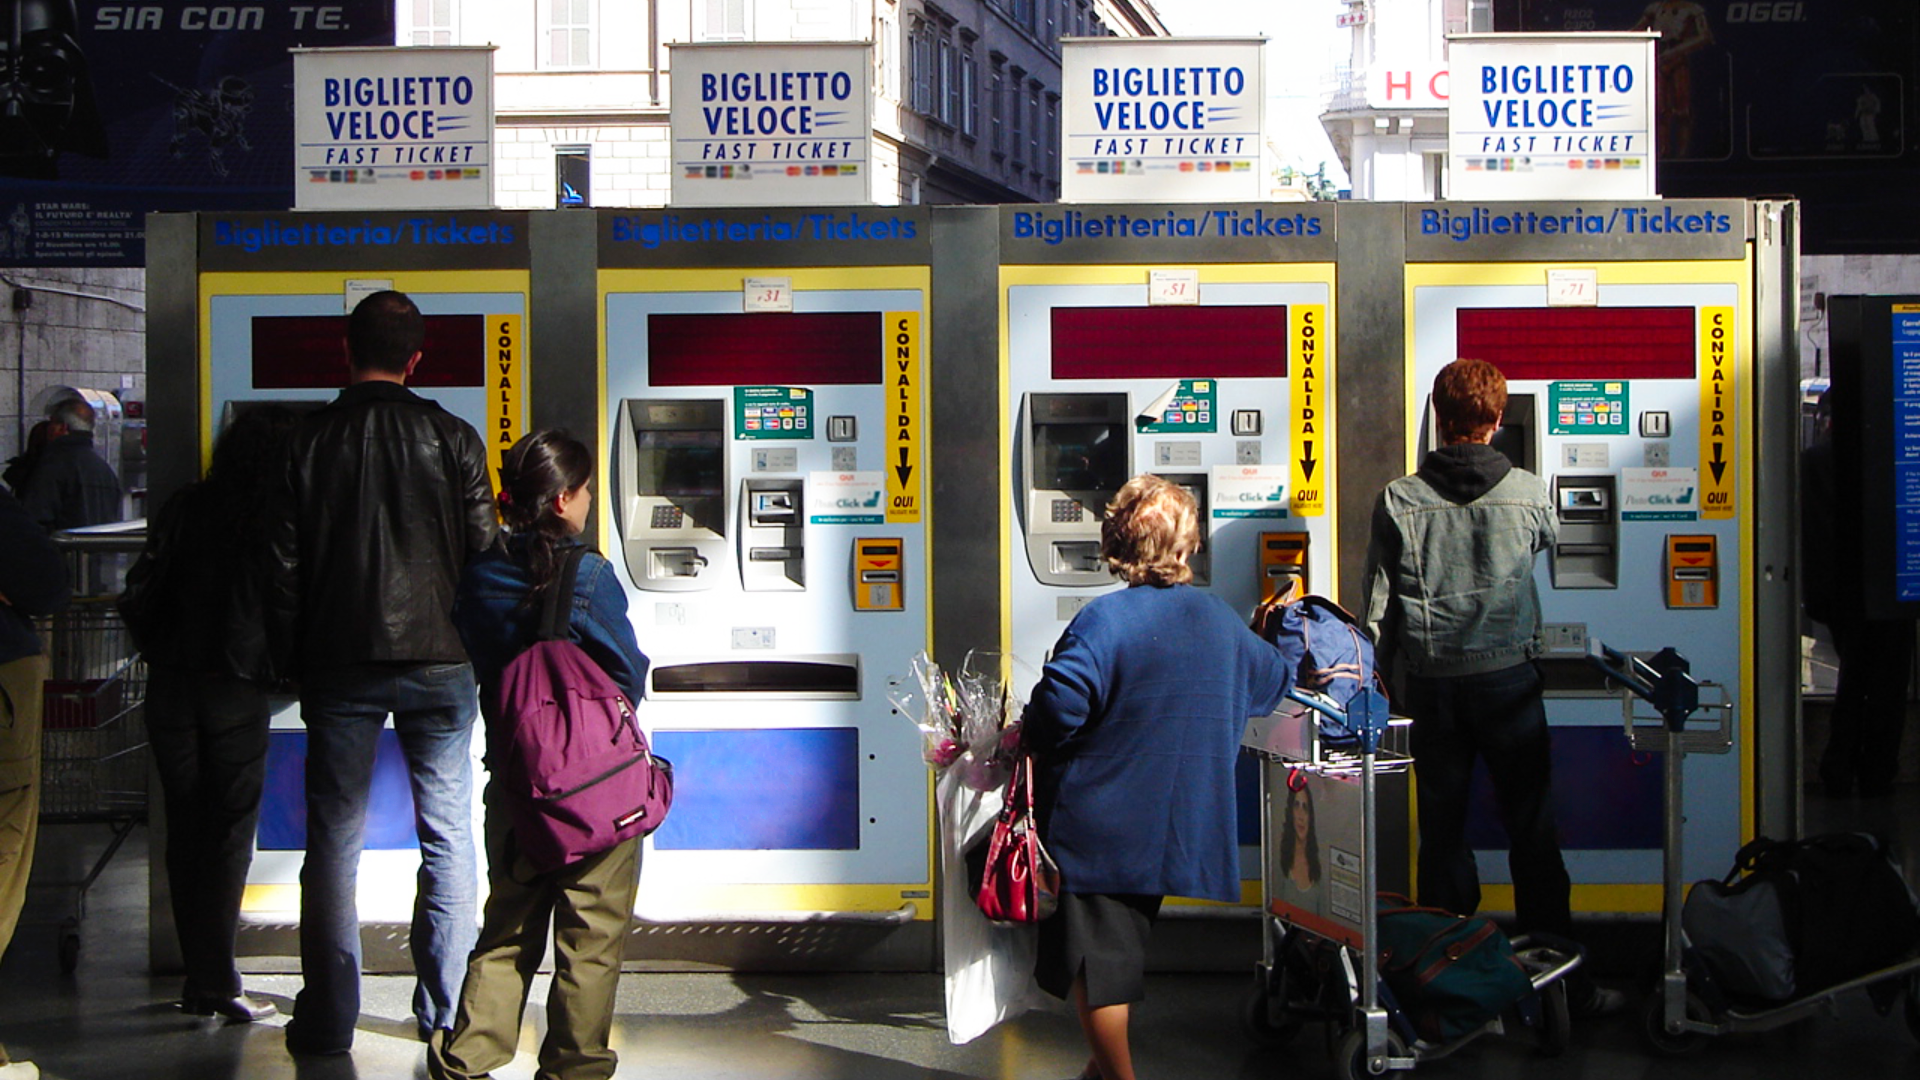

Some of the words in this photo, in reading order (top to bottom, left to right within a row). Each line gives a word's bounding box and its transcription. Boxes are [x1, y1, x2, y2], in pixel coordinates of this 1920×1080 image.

[94, 6, 164, 31] SIA
[180, 6, 265, 31] CON
[290, 6, 350, 31] TE.
[1725, 1, 1807, 24] OGGI.
[325, 76, 473, 107] BIGLIETTO
[702, 71, 851, 102] BIGLIETTO
[1093, 67, 1244, 97] BIGLIETTO
[1482, 64, 1633, 94] BIGLIETTO
[326, 110, 434, 140] VELOCE
[703, 106, 812, 135] VELOCE
[1094, 101, 1204, 130] VELOCE
[1483, 99, 1593, 128] VELOCE
[326, 148, 379, 164] FAST
[395, 146, 473, 163] TICKET
[703, 143, 757, 160] FAST
[773, 142, 851, 159] TICKET
[1094, 138, 1148, 155] FAST
[1165, 138, 1244, 154] TICKET
[1483, 136, 1536, 153] FAST
[1554, 135, 1633, 152] TICKET
[35, 203, 59, 211] STAR
[35, 211, 44, 219] IL
[46, 211, 84, 219] FUTURO
[215, 219, 515, 252] Biglietteria/Tickets
[613, 214, 917, 248] Biglietteria/Tickets
[1014, 209, 1321, 244] Biglietteria/Tickets
[1421, 207, 1731, 241] Biglietteria/Tickets
[498, 321, 512, 443] CONVALIDA
[896, 319, 911, 441] CONVALIDA
[1301, 311, 1315, 435] CONVALIDA
[1711, 313, 1725, 437] CONVALIDA
[893, 496, 914, 508] QUI
[1297, 489, 1318, 501] QUI
[1706, 492, 1728, 504] QUI
